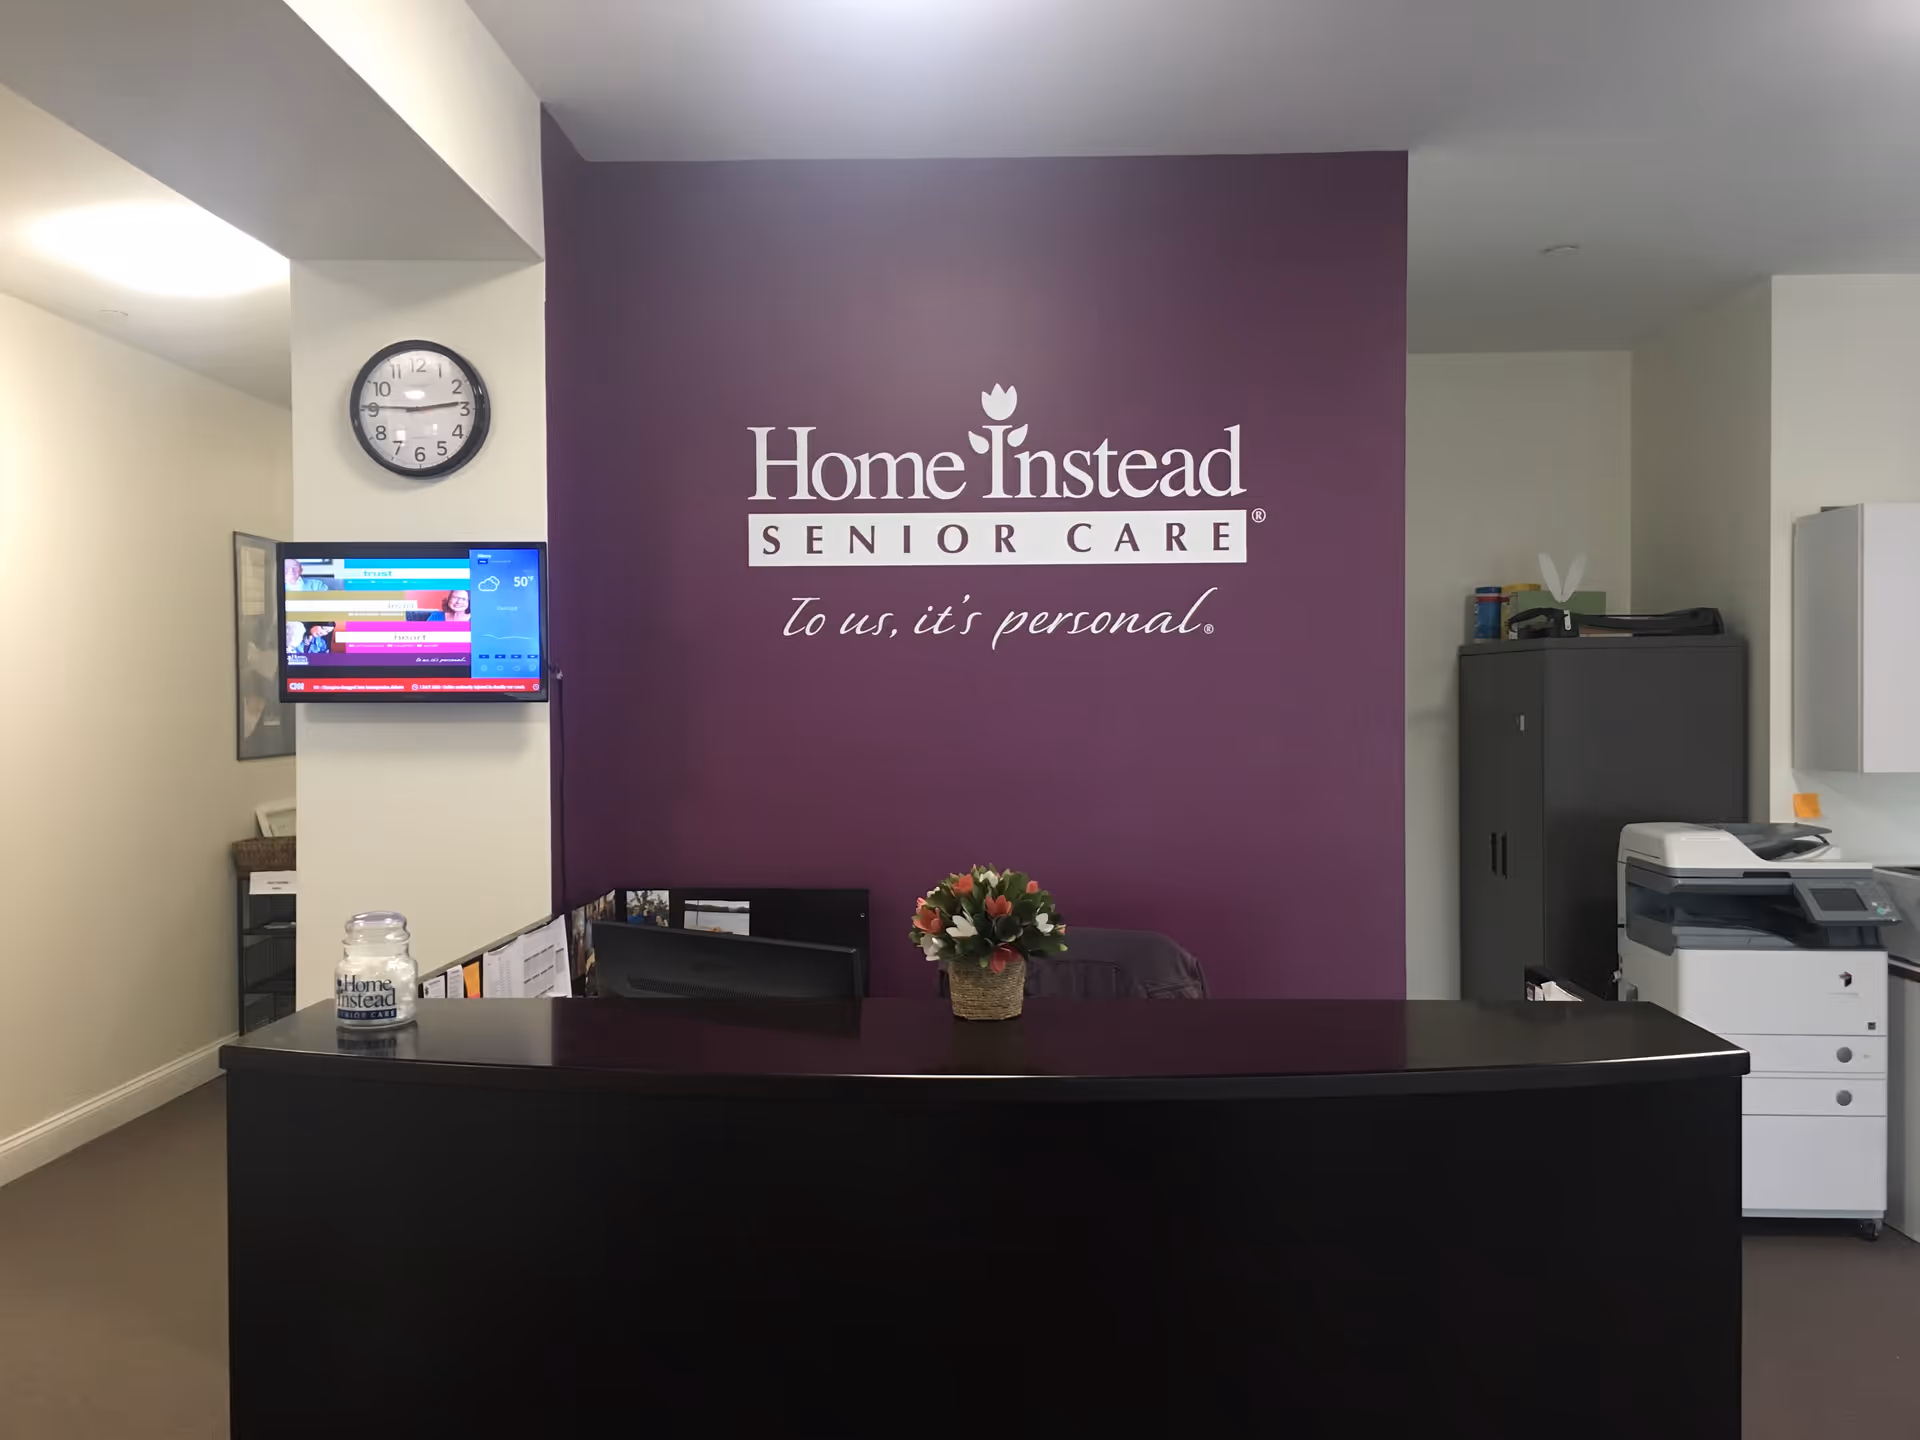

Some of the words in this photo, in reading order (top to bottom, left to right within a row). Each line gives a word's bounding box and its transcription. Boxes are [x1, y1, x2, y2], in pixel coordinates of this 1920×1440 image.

[390, 363, 402, 379] 11
[409, 358, 427, 373] 12
[437, 363, 443, 378] 1
[373, 381, 391, 397] 10
[451, 378, 463, 395] 2
[367, 402, 380, 418] 9
[459, 401, 471, 417] 3
[375, 425, 387, 441] 8
[451, 424, 464, 440] 4
[392, 440, 403, 456] 7
[414, 446, 426, 462] 6
[436, 440, 448, 456] 5
[747, 426, 967, 501] Home
[982, 424, 1247, 499] Instead
[763, 524, 1017, 555] SENIOR
[1066, 522, 1230, 553] CARE
[363, 569, 393, 577] trust
[782, 597, 826, 637] To
[839, 612, 898, 638] us,
[913, 594, 982, 635] it's
[343, 973, 392, 993] Home
